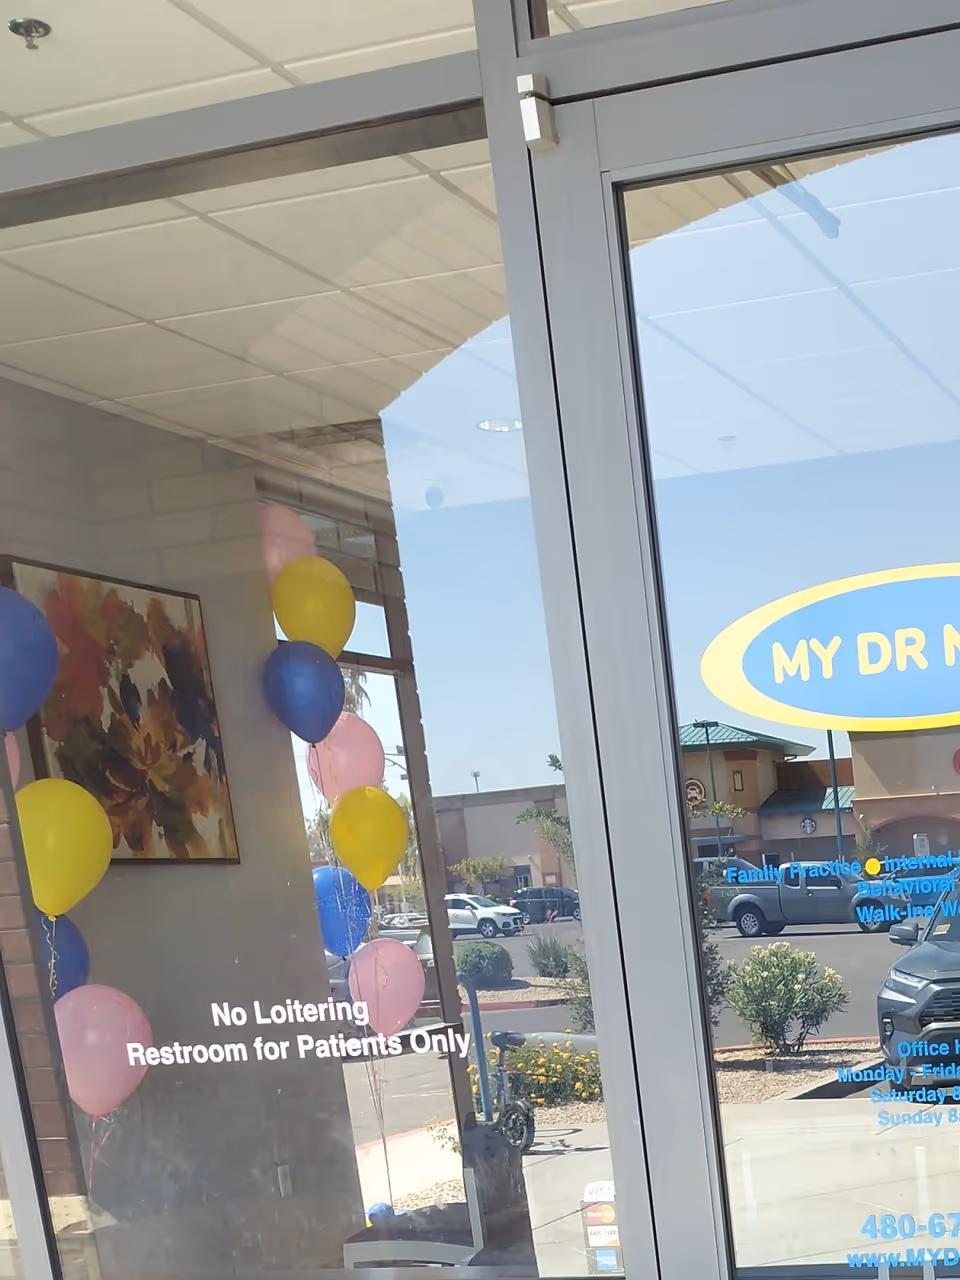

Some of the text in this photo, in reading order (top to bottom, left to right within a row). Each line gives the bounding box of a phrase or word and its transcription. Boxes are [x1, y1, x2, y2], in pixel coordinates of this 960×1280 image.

[771, 635, 842, 684] MY
[857, 627, 929, 676] DR
[726, 864, 784, 884] Family
[789, 859, 861, 879] Practice
[884, 851, 952, 872] Internal
[857, 873, 955, 898] Behavioral
[856, 903, 935, 923] Walk-Ins
[210, 996, 370, 1027] No Loitering
[126, 1028, 471, 1066] Restroom for Patients Only
[897, 1040, 950, 1057] Office
[837, 1064, 906, 1084] Monday
[869, 1086, 946, 1105] Saturday
[877, 1109, 942, 1127] Sunday
